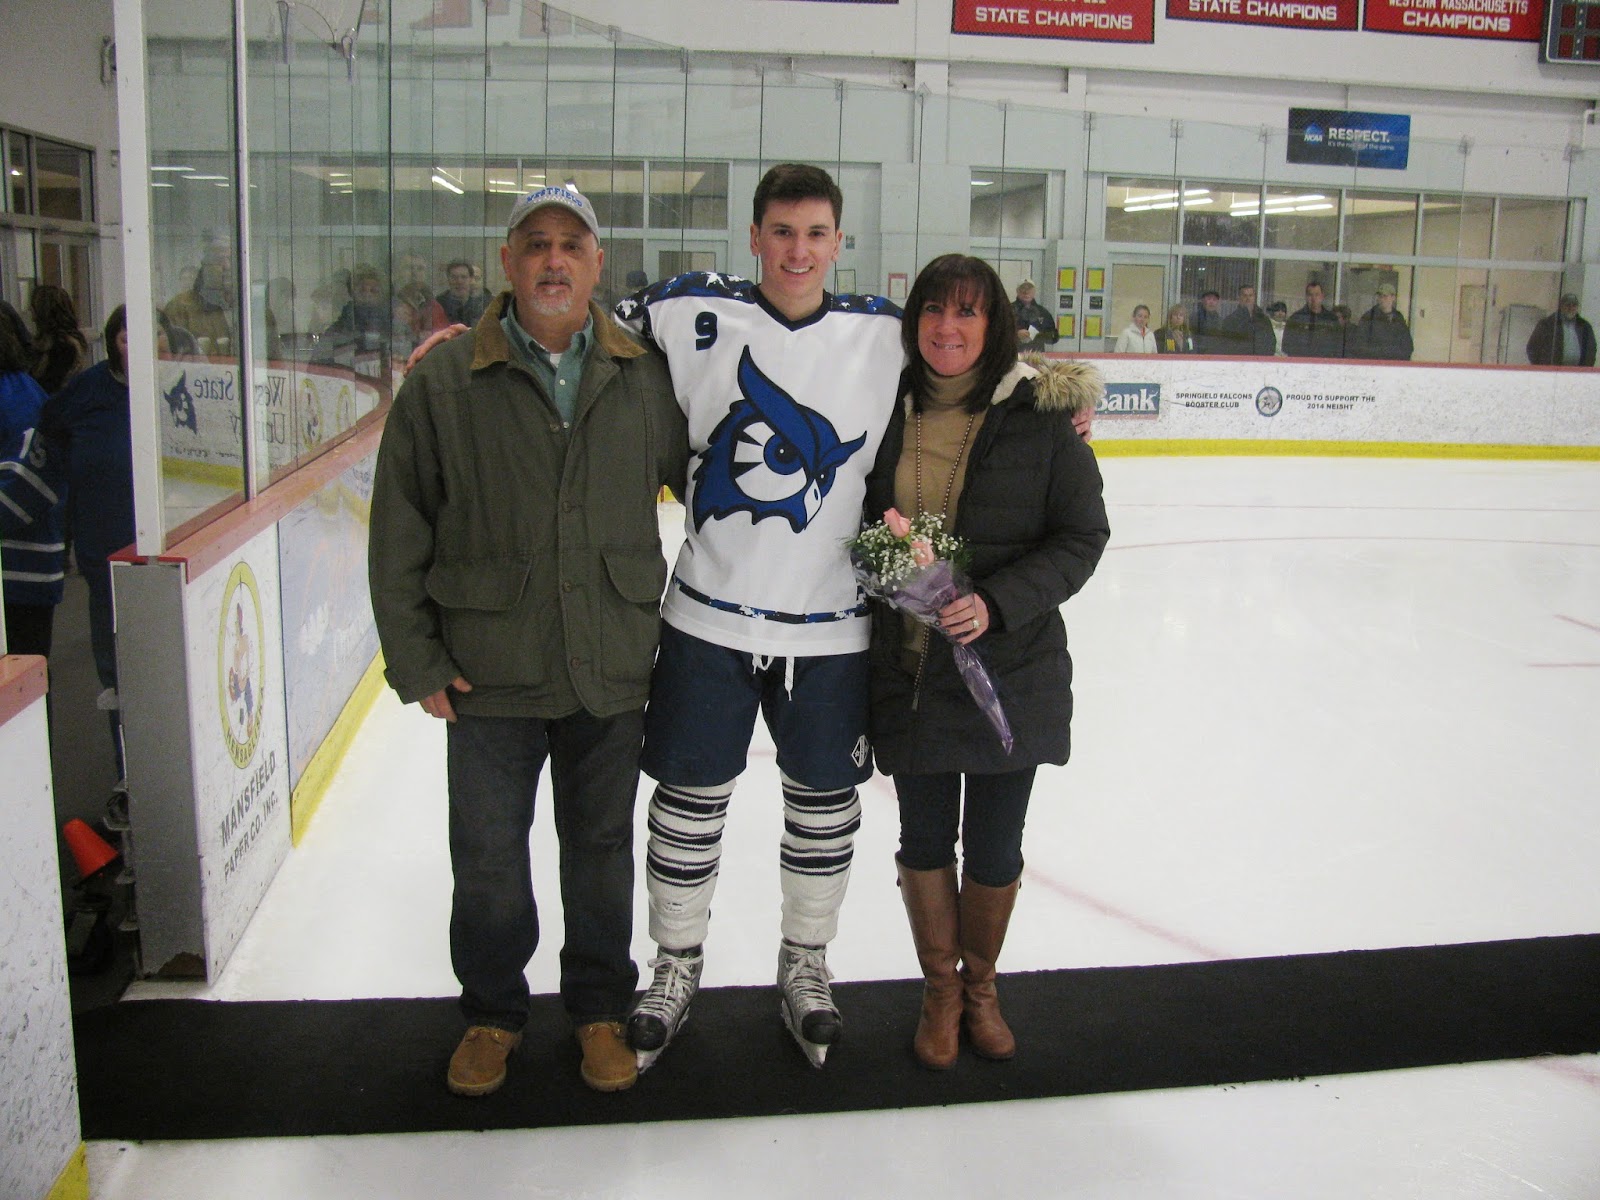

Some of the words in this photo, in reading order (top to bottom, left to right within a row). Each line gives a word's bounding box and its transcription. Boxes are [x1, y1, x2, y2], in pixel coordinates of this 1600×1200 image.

[975, 6, 1030, 24] STATE
[1035, 10, 1133, 30] CHAMPIONS
[1189, 0, 1240, 14] STATE
[1246, 2, 1337, 20] CHAMPIONS
[1441, 0, 1529, 15] MASSACHUSETTS
[1402, 10, 1511, 32] CHAMPIONS
[1303, 134, 1323, 143] NCAA
[526, 186, 583, 208] WESTFIELD
[695, 311, 718, 351] 9
[221, 750, 276, 848] MANSFIELD
